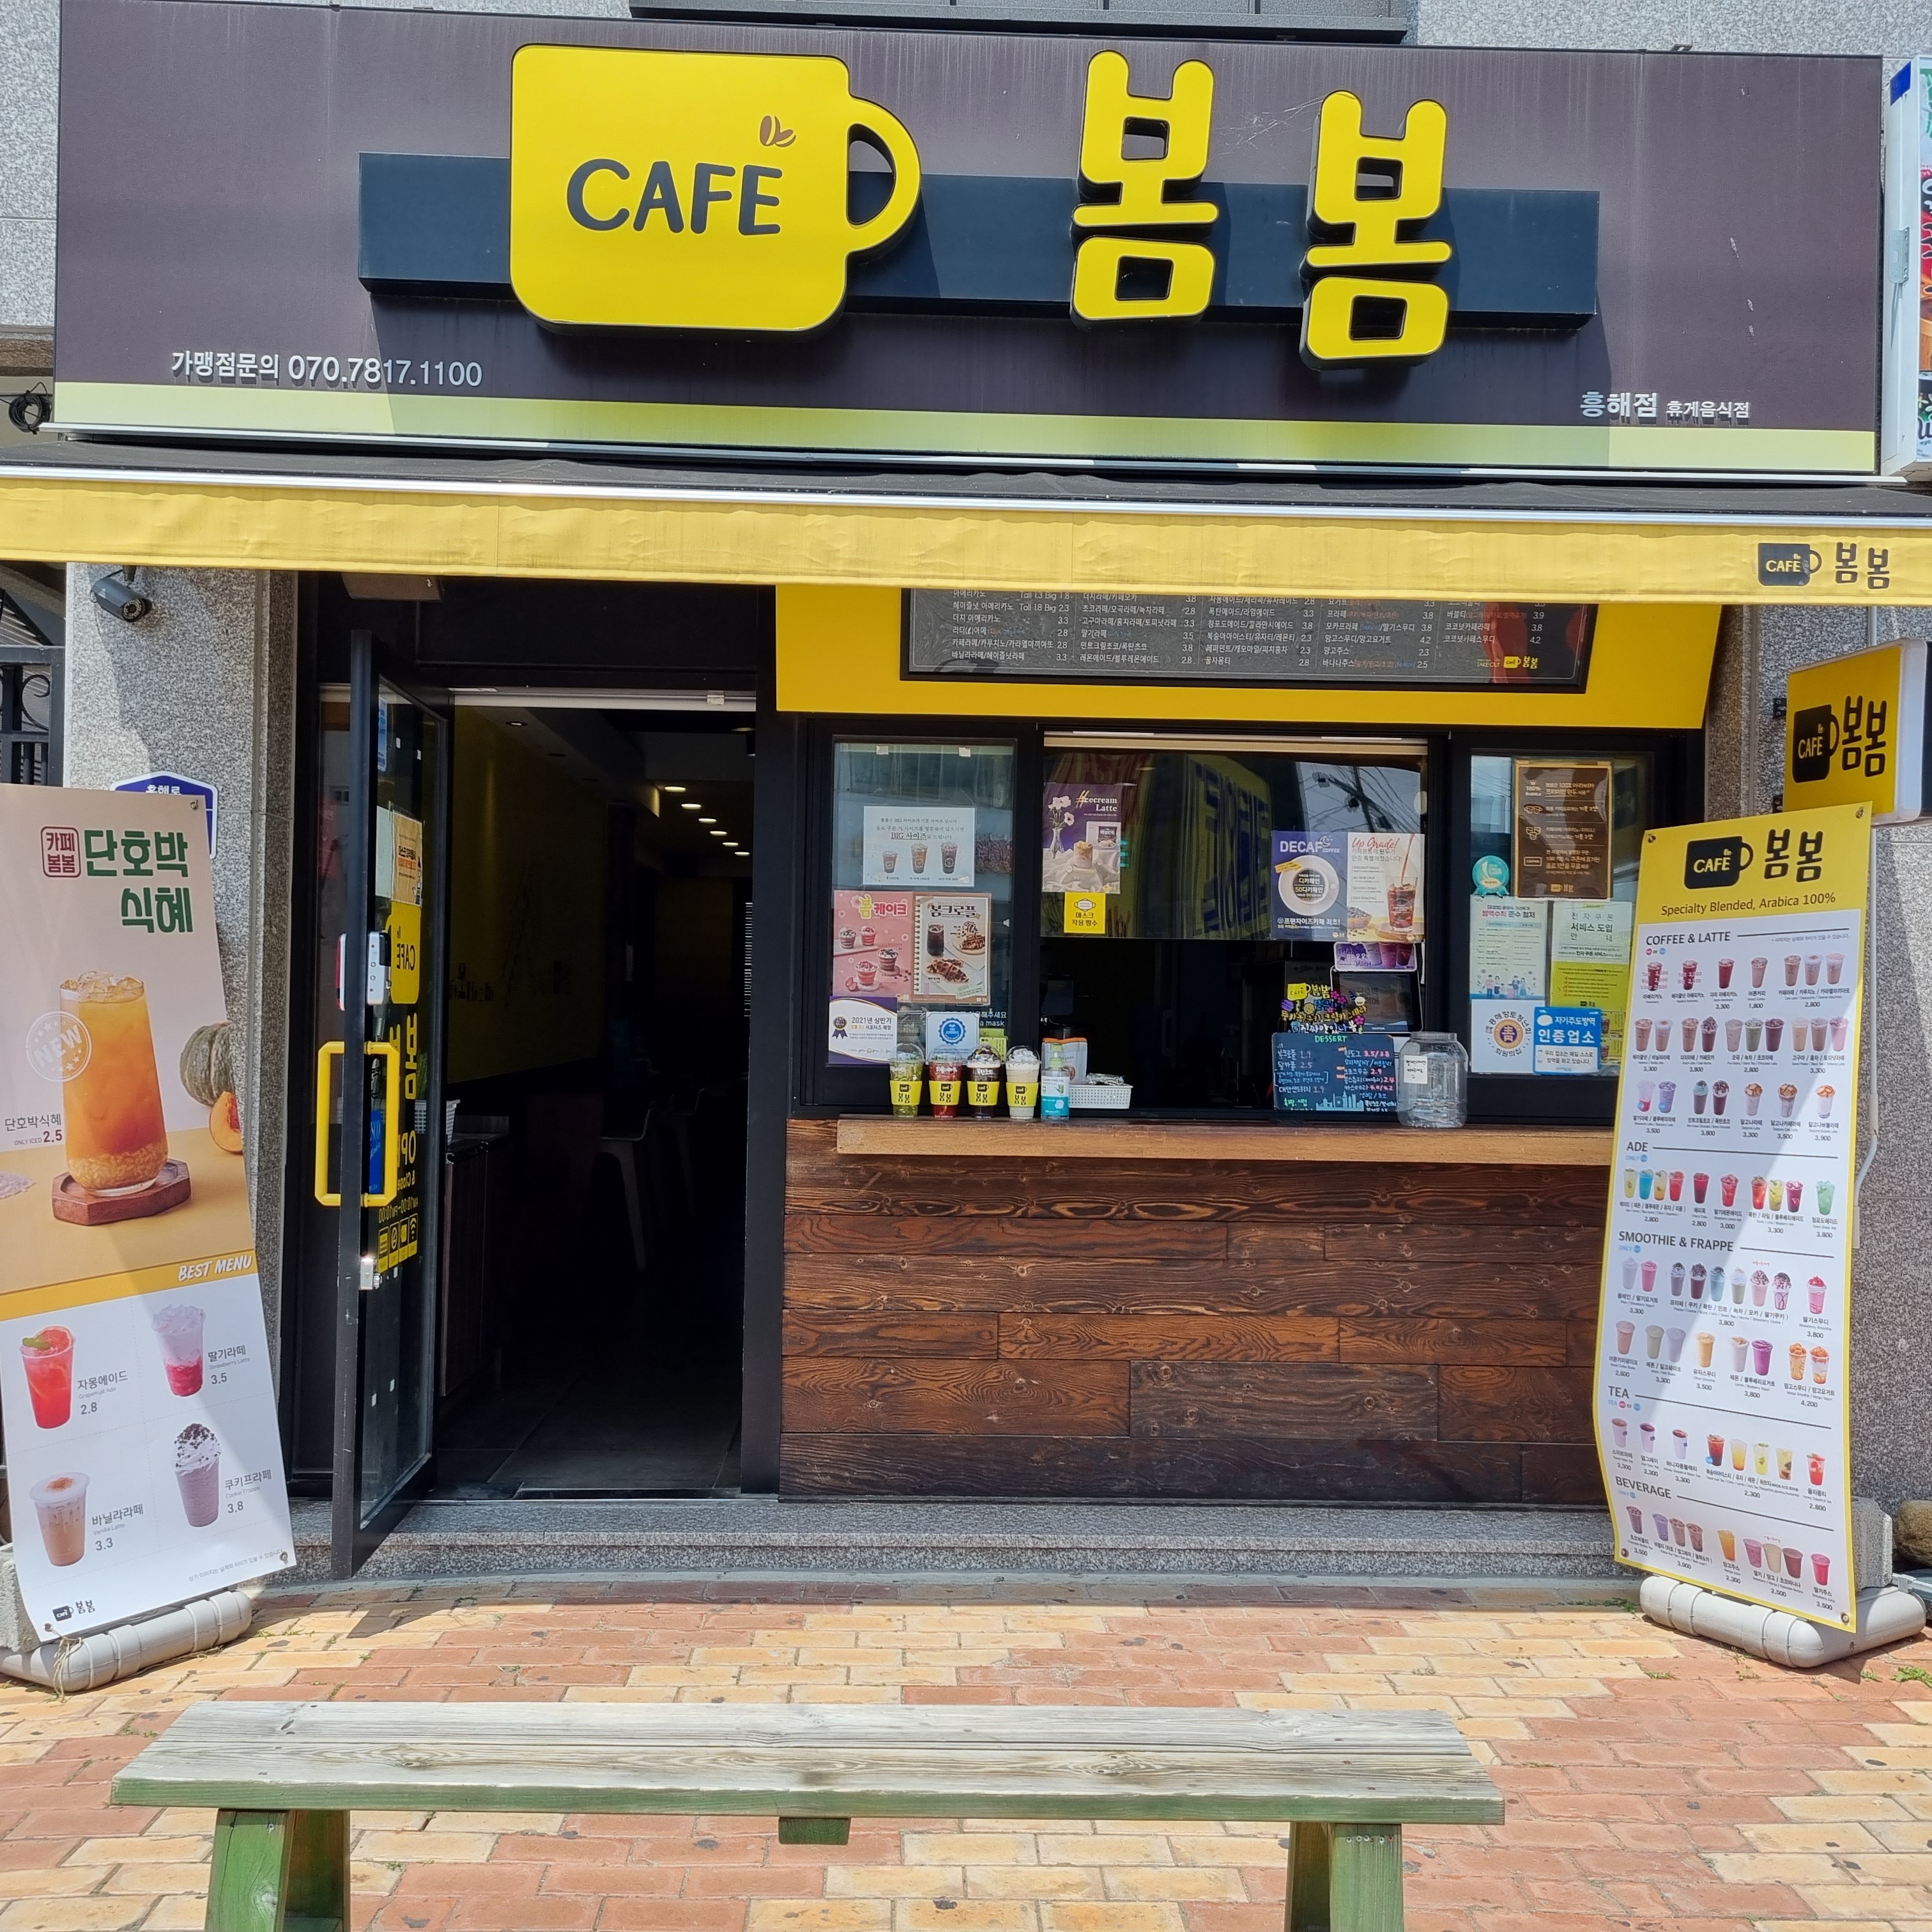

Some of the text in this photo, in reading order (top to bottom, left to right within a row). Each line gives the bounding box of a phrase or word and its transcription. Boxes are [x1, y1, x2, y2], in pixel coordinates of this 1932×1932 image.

[567, 50, 1452, 371] CAFE 봄봄
[172, 349, 483, 388] 가맹점문의 070.7817.1100
[1580, 390, 1751, 420] 흥해점 휴게음식점
[1766, 542, 1890, 589] CAFE 봄봄
[953, 602, 979, 610] 헤이즐넛
[981, 602, 1013, 611] 아메리카노
[1045, 604, 1056, 613] Big
[953, 614, 965, 622] 더치
[1081, 629, 1107, 638] 딸기라떼
[1324, 647, 1349, 655] 망고주스
[1798, 695, 1887, 778] CAFE 봄봄
[46, 832, 75, 852] 카페
[1280, 841, 1322, 853] DECAF
[1352, 837, 1400, 852] Up Grade!
[84, 829, 188, 877] 단호박
[1694, 829, 1823, 883] CAFE 봄봄
[48, 854, 75, 873] 봄봄
[121, 887, 193, 933] 식혜
[858, 894, 907, 919] 봄 케이크
[1661, 892, 1836, 916] Specialty Blended, Arabica 100%
[1570, 923, 1613, 933] 서비스 도입
[1646, 931, 1731, 946] COFFEE & LATTE
[874, 1016, 892, 1025] 상반기
[1555, 1016, 1595, 1026] 자기주도방역
[1538, 1029, 1595, 1043] 인증업소
[33, 1025, 82, 1068] NEW
[43, 1130, 62, 1142] 2.5
[1627, 1142, 1648, 1152] ADE
[1618, 1231, 1734, 1252] SMOOTHIE & FRAPPE
[178, 1255, 253, 1281] BEST MENU
[208, 1345, 246, 1362] 딸기라떼
[77, 1370, 128, 1391] 자몽에이드
[211, 1372, 227, 1384] 3.5
[1607, 1386, 1629, 1399] TEA
[80, 1402, 98, 1415] 2.8
[224, 1469, 272, 1491] 쿠키프라페
[1616, 1476, 1671, 1499] BEVERAGE
[92, 1503, 144, 1527] 바닐라라떼
[227, 1501, 244, 1514] 3.8
[1809, 1503, 1826, 1512] 2,800
[95, 1537, 113, 1551] 3.3
[75, 1599, 96, 1614] 봄봄
[1816, 1601, 1833, 1611] 3,500
